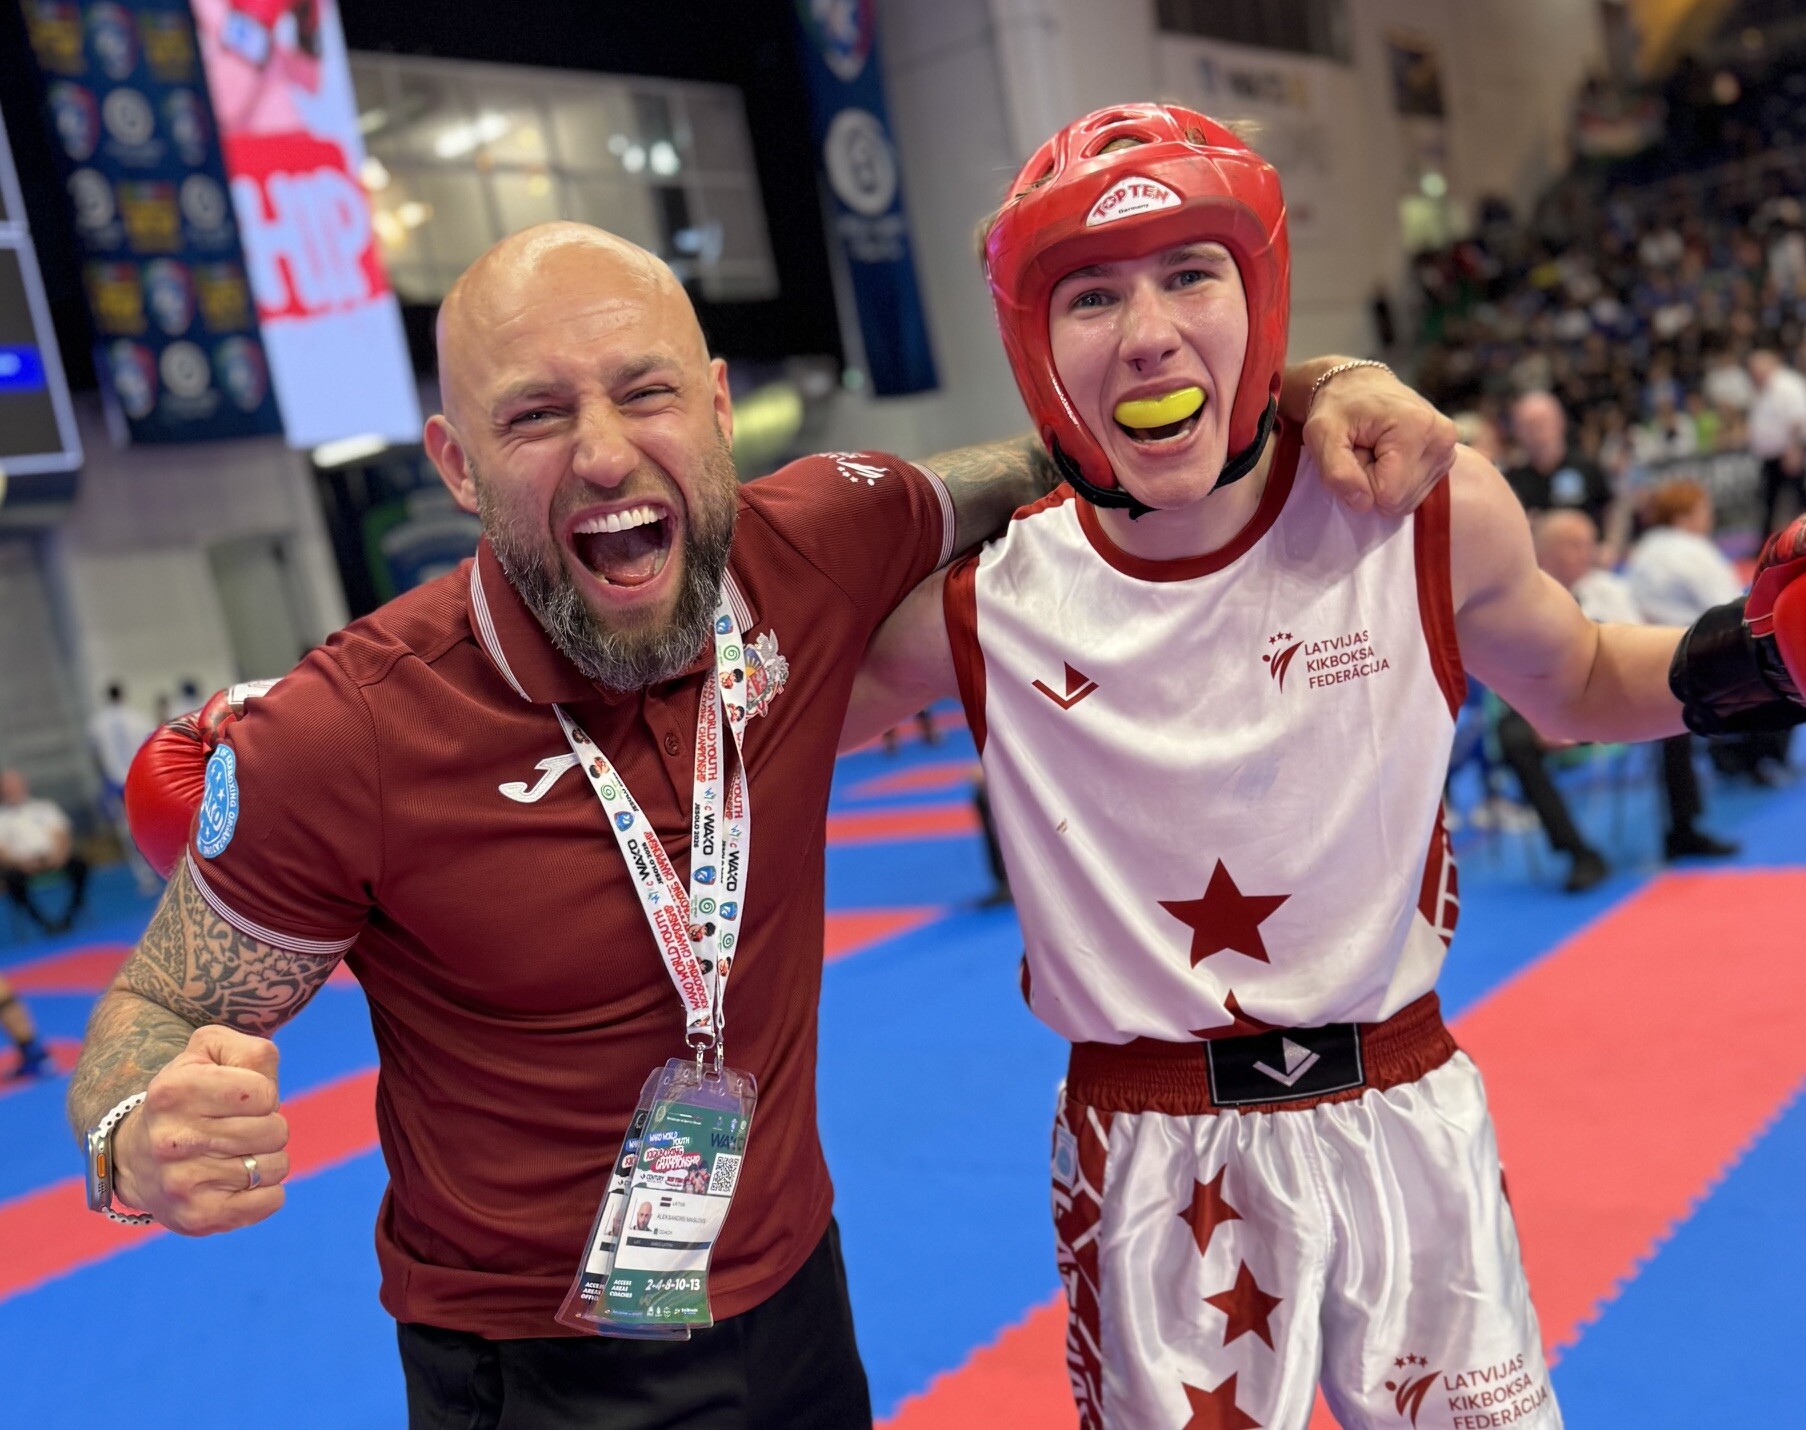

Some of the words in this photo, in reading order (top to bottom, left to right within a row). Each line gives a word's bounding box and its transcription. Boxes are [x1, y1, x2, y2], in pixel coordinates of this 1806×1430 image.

[1092, 188, 1127, 219] TOP
[1128, 183, 1169, 204] TEN
[1118, 203, 1149, 214] Germany
[1304, 629, 1369, 656] LATVIJAS
[1306, 646, 1375, 673] KIKBOKSA
[1309, 658, 1390, 689] FEDERĀCIJA
[707, 743, 717, 781] YOUTH
[693, 802, 701, 829] JESOLO
[653, 909, 675, 948] YOUTH
[668, 946, 691, 982] WORLD
[683, 981, 701, 1011] WAKO
[1443, 1352, 1524, 1392] LATVIJAS
[1448, 1371, 1533, 1412] KIKBOKSA
[1453, 1385, 1548, 1430] FEDERĀCIJA
